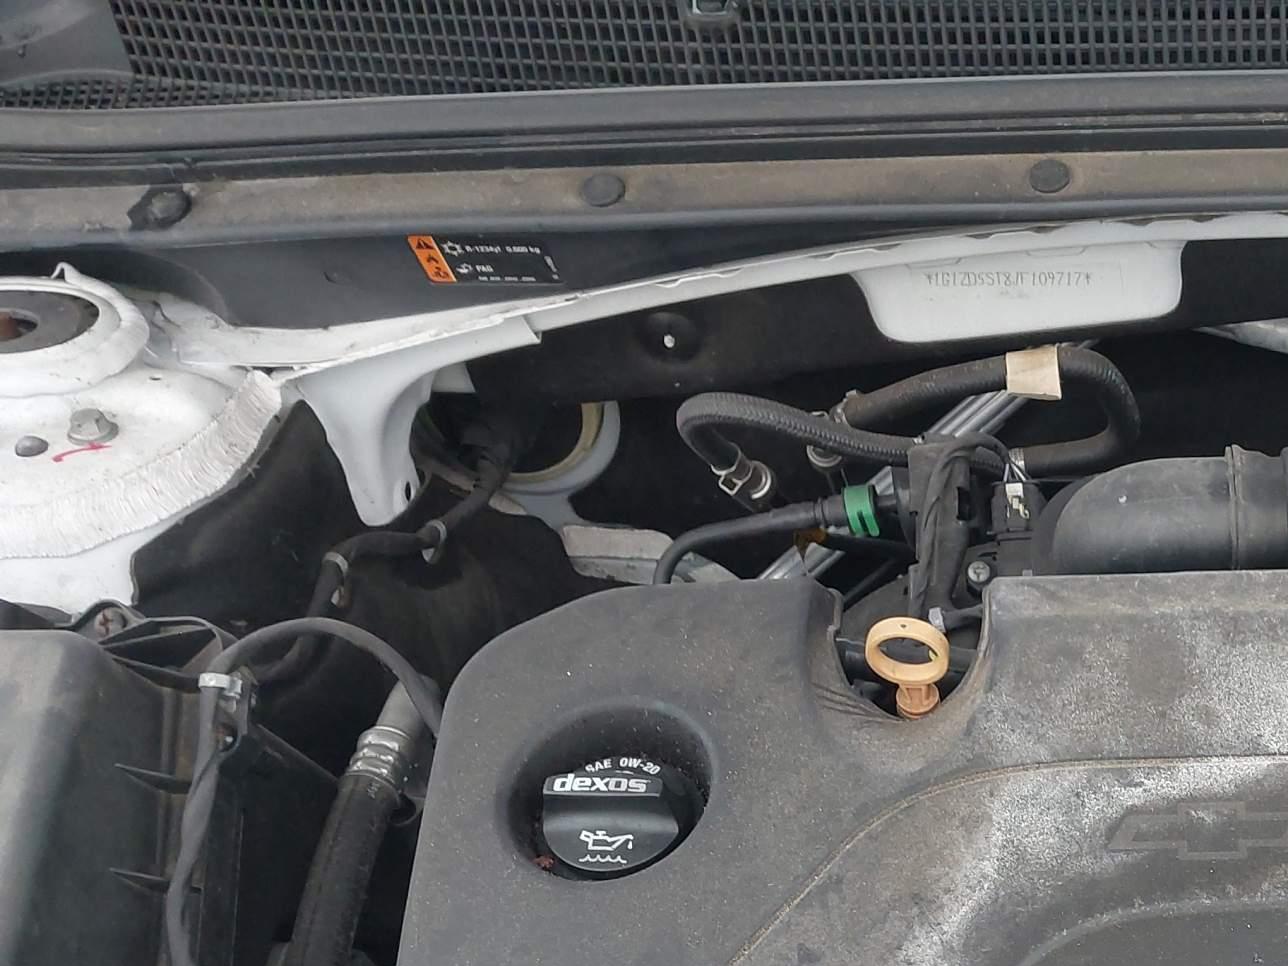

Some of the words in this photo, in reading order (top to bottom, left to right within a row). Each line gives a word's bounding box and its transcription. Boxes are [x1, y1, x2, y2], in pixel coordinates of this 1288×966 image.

[585, 758, 612, 773] SAE
[619, 757, 660, 775] 0W-20
[553, 773, 648, 793] dexos
